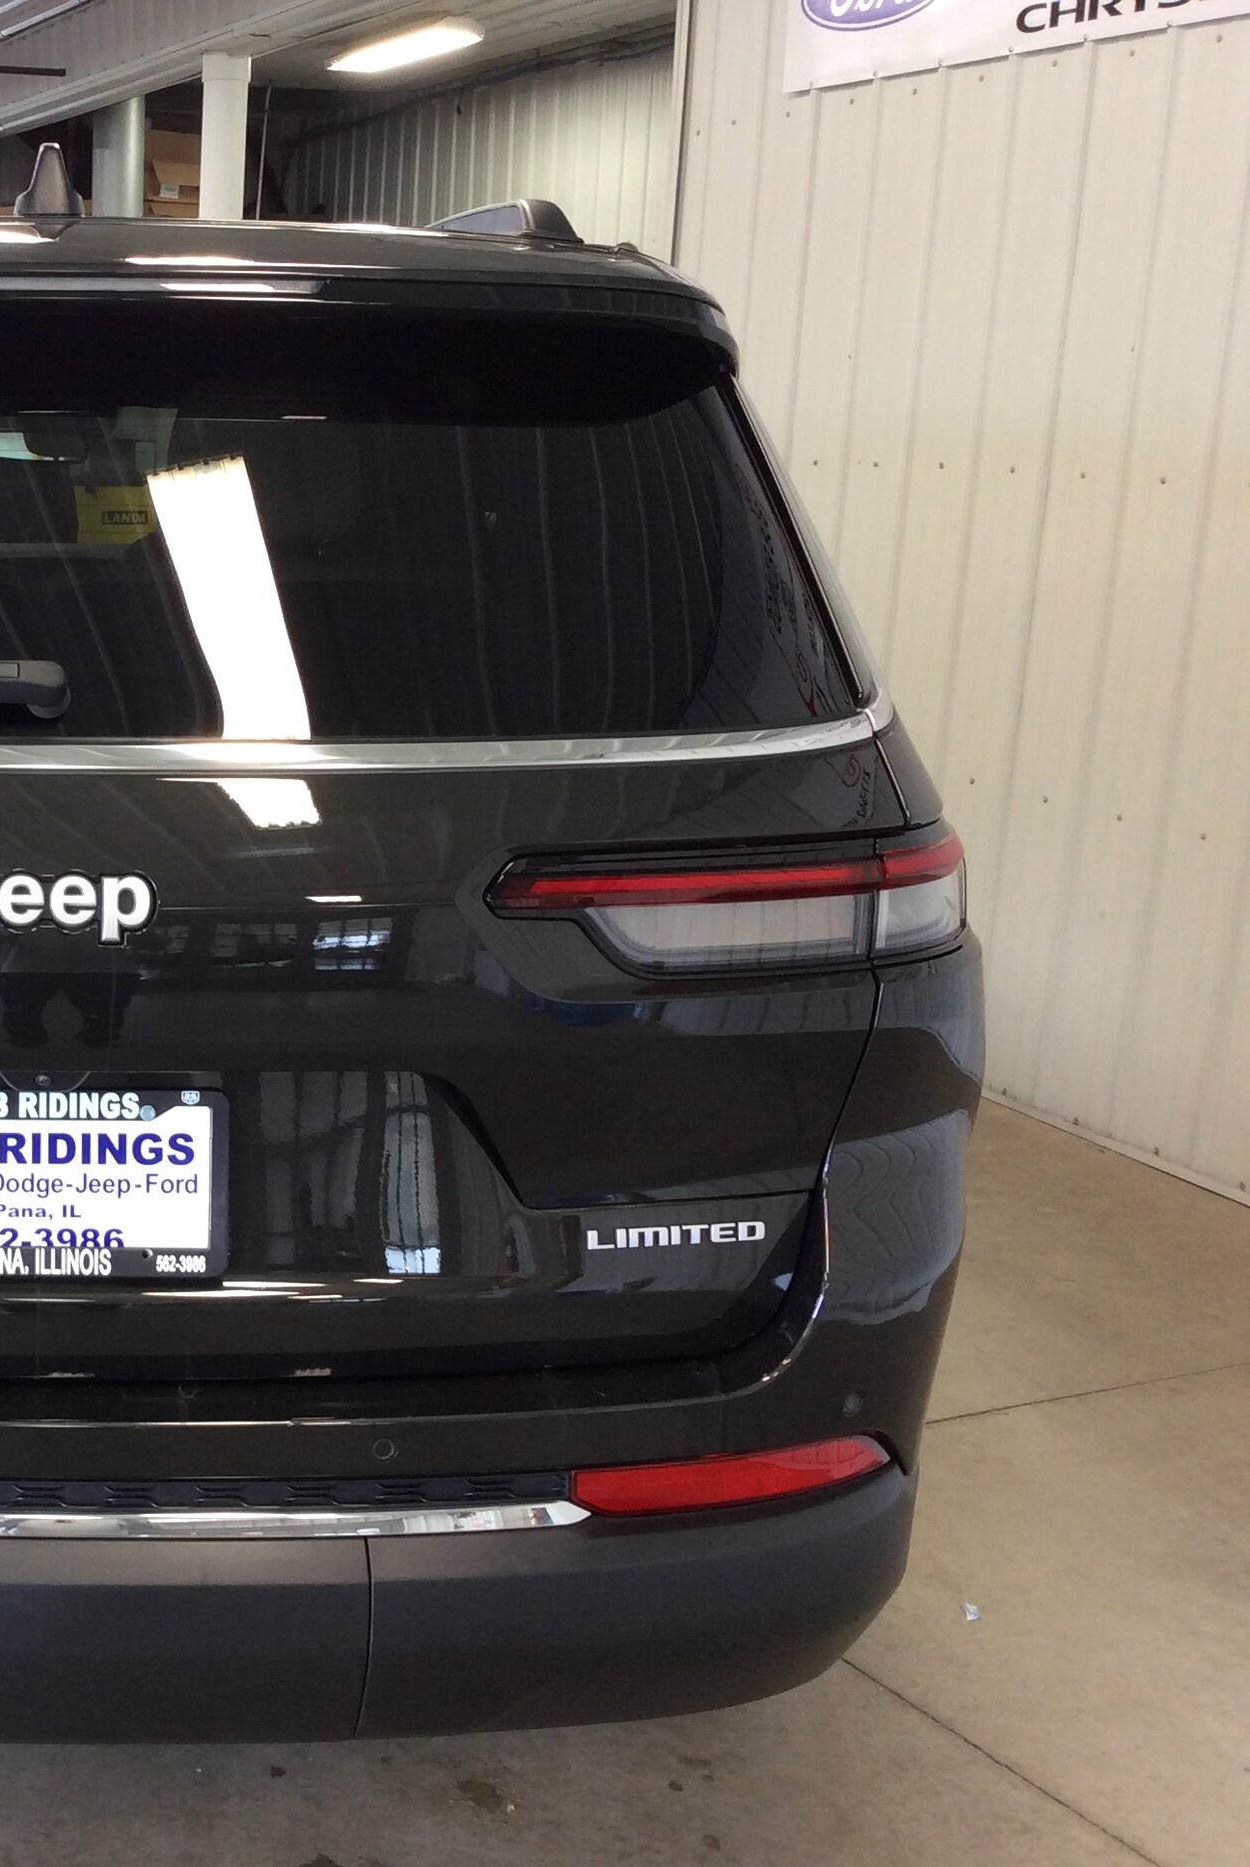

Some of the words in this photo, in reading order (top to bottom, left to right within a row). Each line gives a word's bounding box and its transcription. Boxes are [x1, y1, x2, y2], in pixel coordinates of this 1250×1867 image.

[17, 1092, 140, 1120] RIDINGS
[62, 1204, 82, 1219] IL
[587, 1221, 766, 1250] LIMITED
[35, 1248, 113, 1276] ILLINOIS
